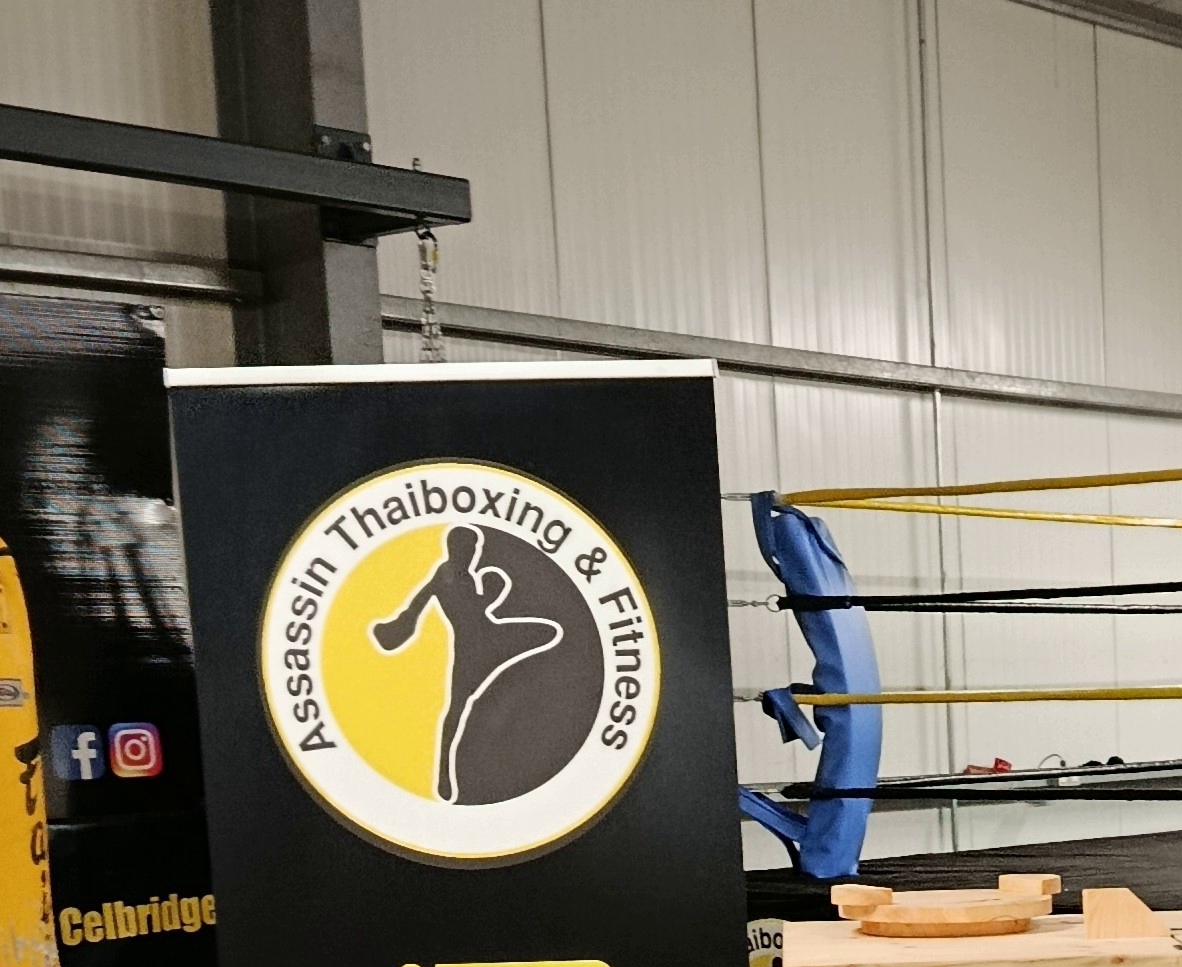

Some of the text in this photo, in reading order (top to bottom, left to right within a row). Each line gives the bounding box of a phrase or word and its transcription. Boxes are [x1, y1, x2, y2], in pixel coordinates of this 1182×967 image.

[284, 478, 647, 753] Assassin Thaiboxing & Fitness
[58, 893, 217, 946] Celbridge
